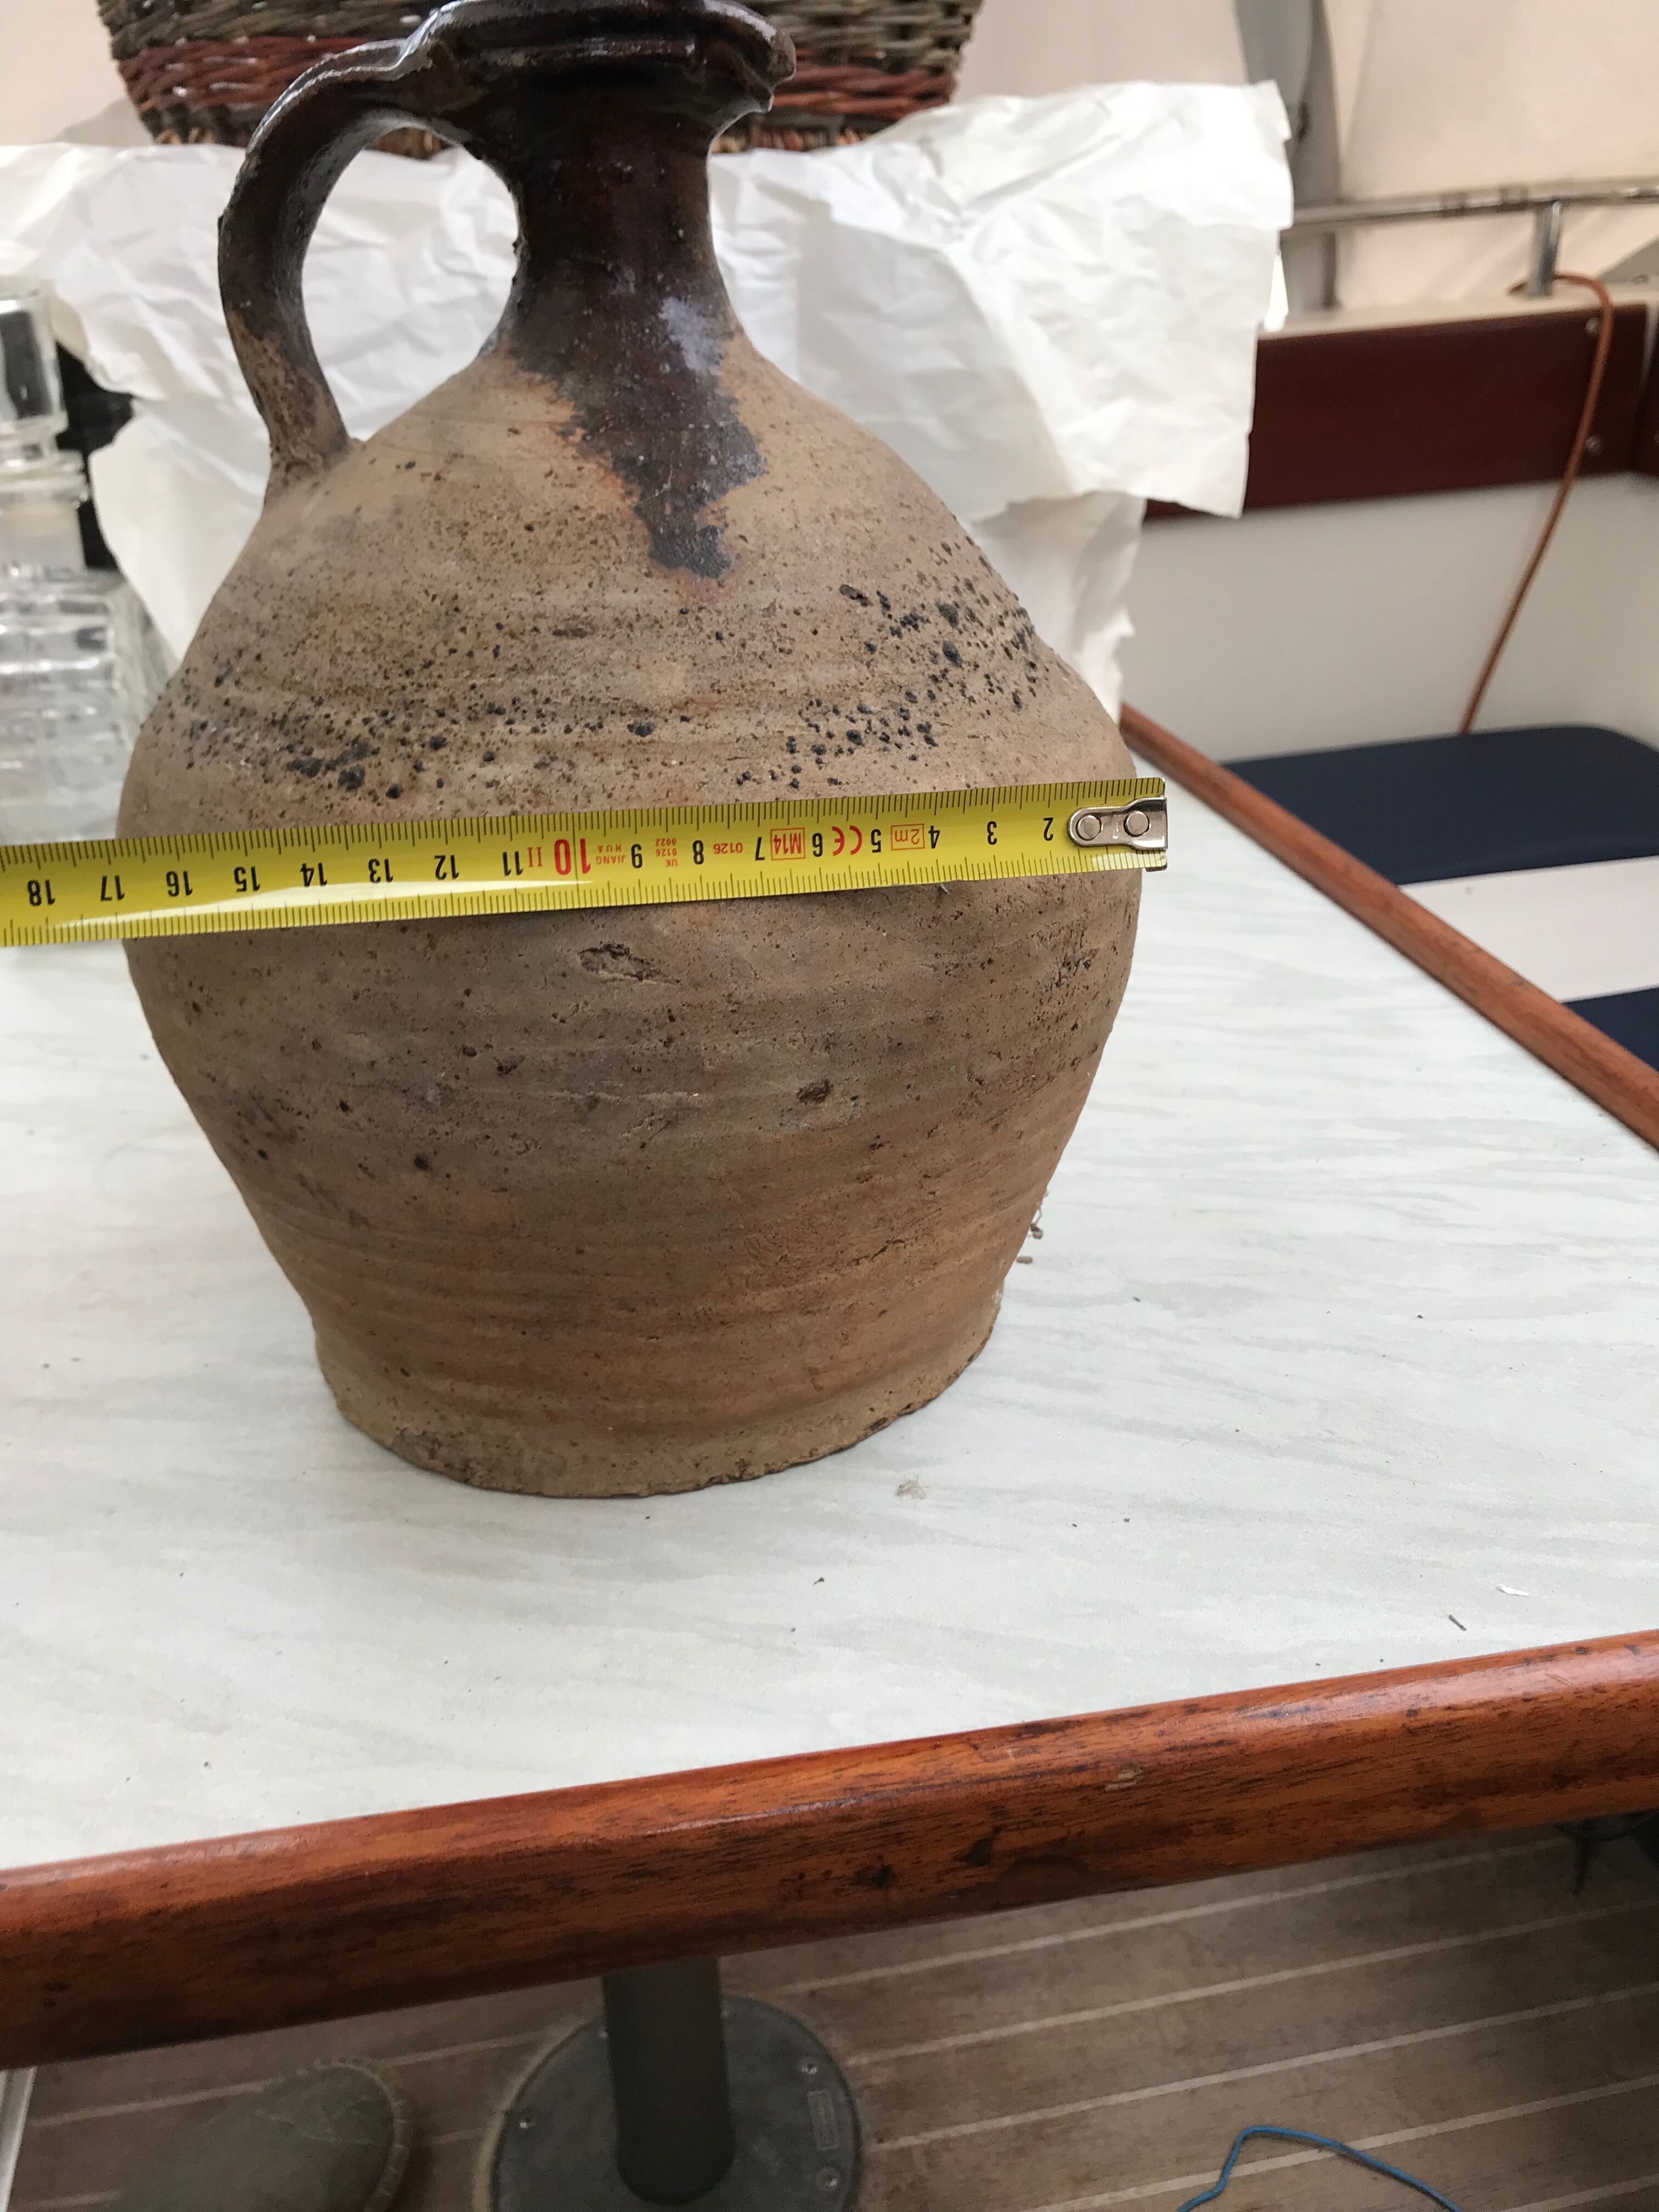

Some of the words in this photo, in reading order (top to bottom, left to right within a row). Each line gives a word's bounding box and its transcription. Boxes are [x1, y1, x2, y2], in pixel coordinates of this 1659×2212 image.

[831, 824, 863, 857] CE
[870, 828, 882, 853] 5
[894, 828, 920, 845] 2m
[928, 825, 940, 849] 4
[987, 821, 998, 845] 3
[1042, 817, 1054, 841] 2
[654, 837, 677, 847] 0022
[655, 847, 677, 857] 0126
[692, 839, 705, 865] 8
[713, 842, 743, 855] 0126
[754, 836, 766, 861] 7
[773, 832, 803, 855] M14
[811, 832, 823, 857] 6
[435, 854, 459, 881] 12
[503, 851, 523, 876] 11
[554, 838, 591, 875] 10
[596, 854, 626, 865] JIANG
[630, 843, 644, 868] 9
[665, 857, 678, 868] UK
[234, 866, 261, 893] 15
[300, 862, 328, 888] 14
[368, 858, 394, 883] 13
[27, 879, 55, 906] 18
[100, 874, 125, 901] 17
[166, 870, 193, 897] 16
